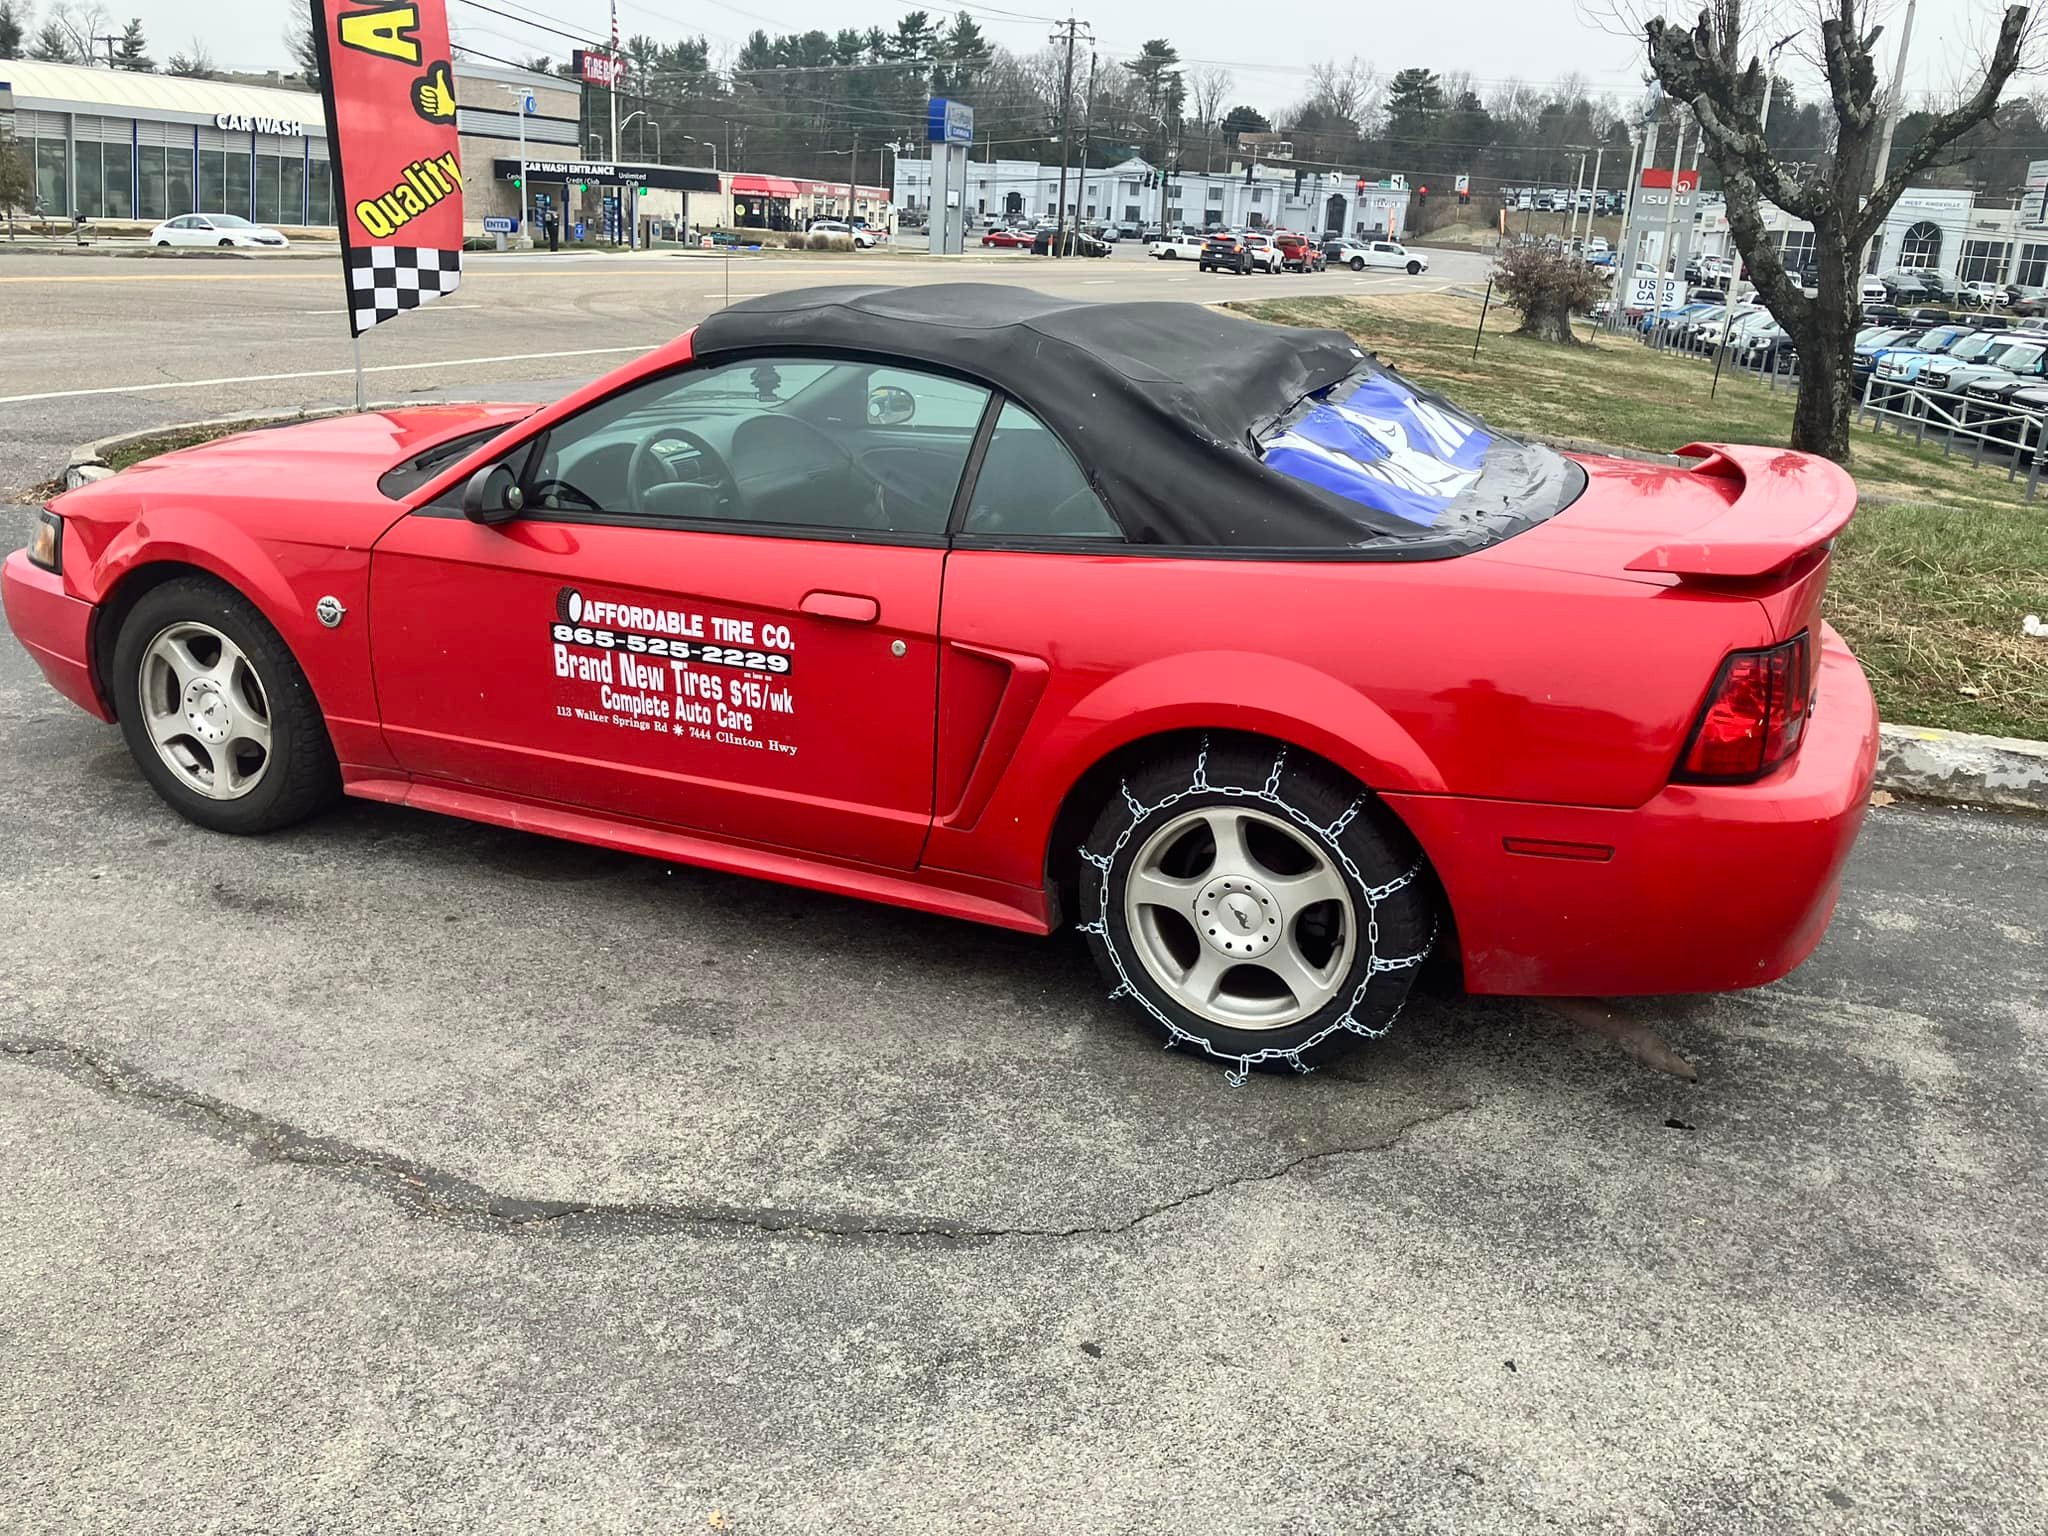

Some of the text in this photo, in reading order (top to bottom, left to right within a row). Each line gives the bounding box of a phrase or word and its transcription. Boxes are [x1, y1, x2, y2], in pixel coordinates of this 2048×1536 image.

[338, 0, 422, 66] A
[216, 113, 303, 136] CAR WASH
[524, 162, 615, 175] CAR WASH ENTRANCE
[618, 172, 646, 180] Unlimited
[355, 150, 463, 239] Quality
[486, 220, 509, 229] ENTER
[1636, 291, 1674, 301] CAS
[1638, 280, 1675, 290] USD
[553, 624, 789, 673] 865-525-2229
[583, 600, 795, 650] AFFORDABLE TIRE CO.
[554, 643, 794, 714] Brand New Tires $15/wk
[556, 706, 797, 756] 113 Walker Springs Rd 7444 Clinton Hwy
[601, 684, 753, 732] Complete Auto Care
